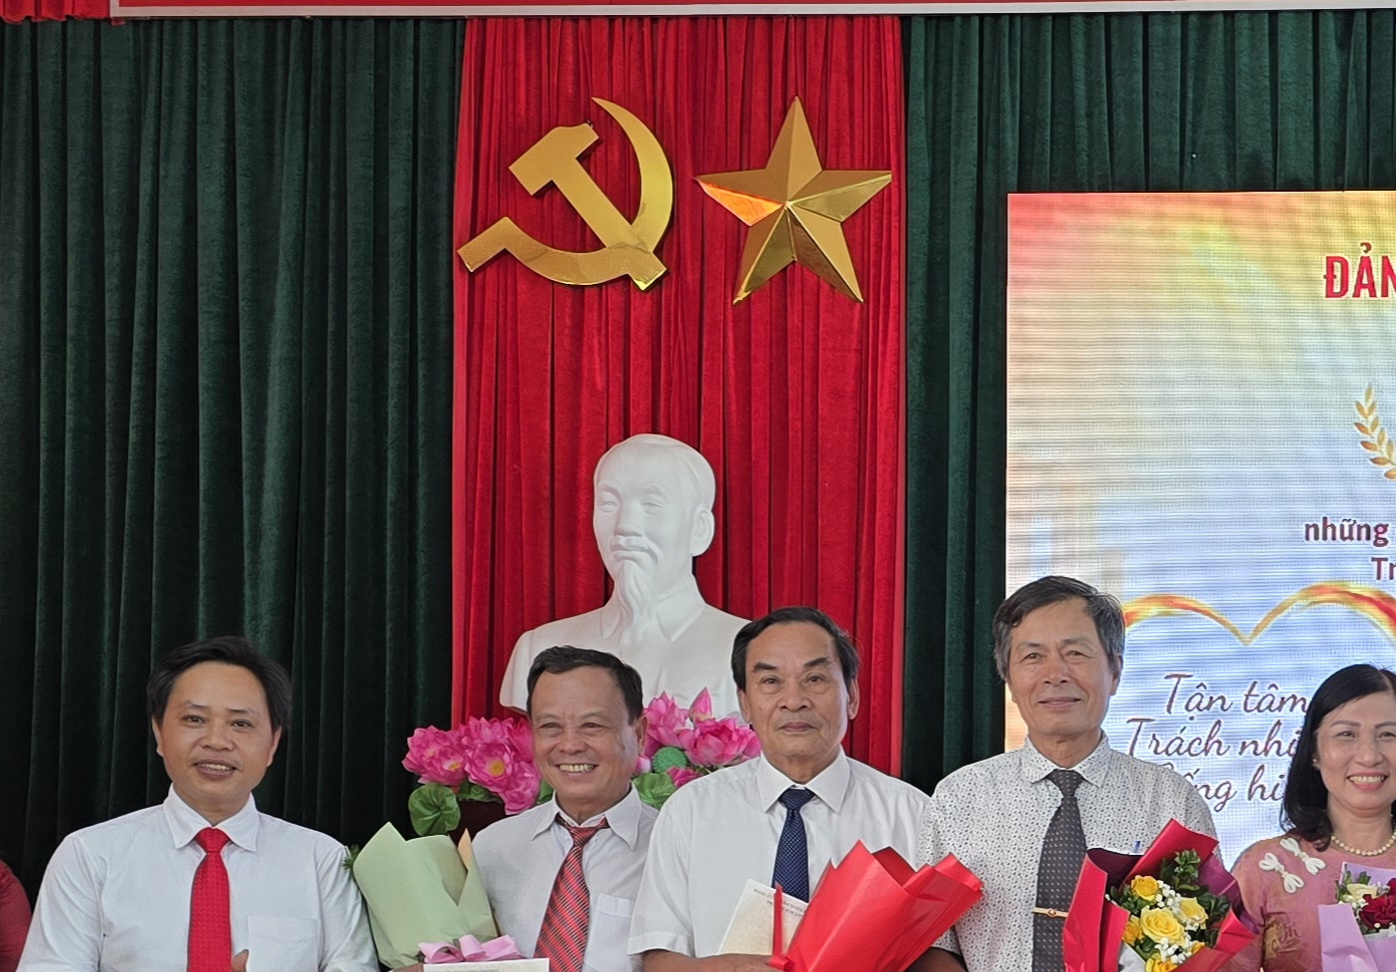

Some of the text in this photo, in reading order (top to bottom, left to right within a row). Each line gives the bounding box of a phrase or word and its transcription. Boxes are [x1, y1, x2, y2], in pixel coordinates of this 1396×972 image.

[1304, 517, 1389, 546] những
[1164, 673, 1308, 721] Tận tâm
[1126, 718, 1303, 757] Trách nhi
